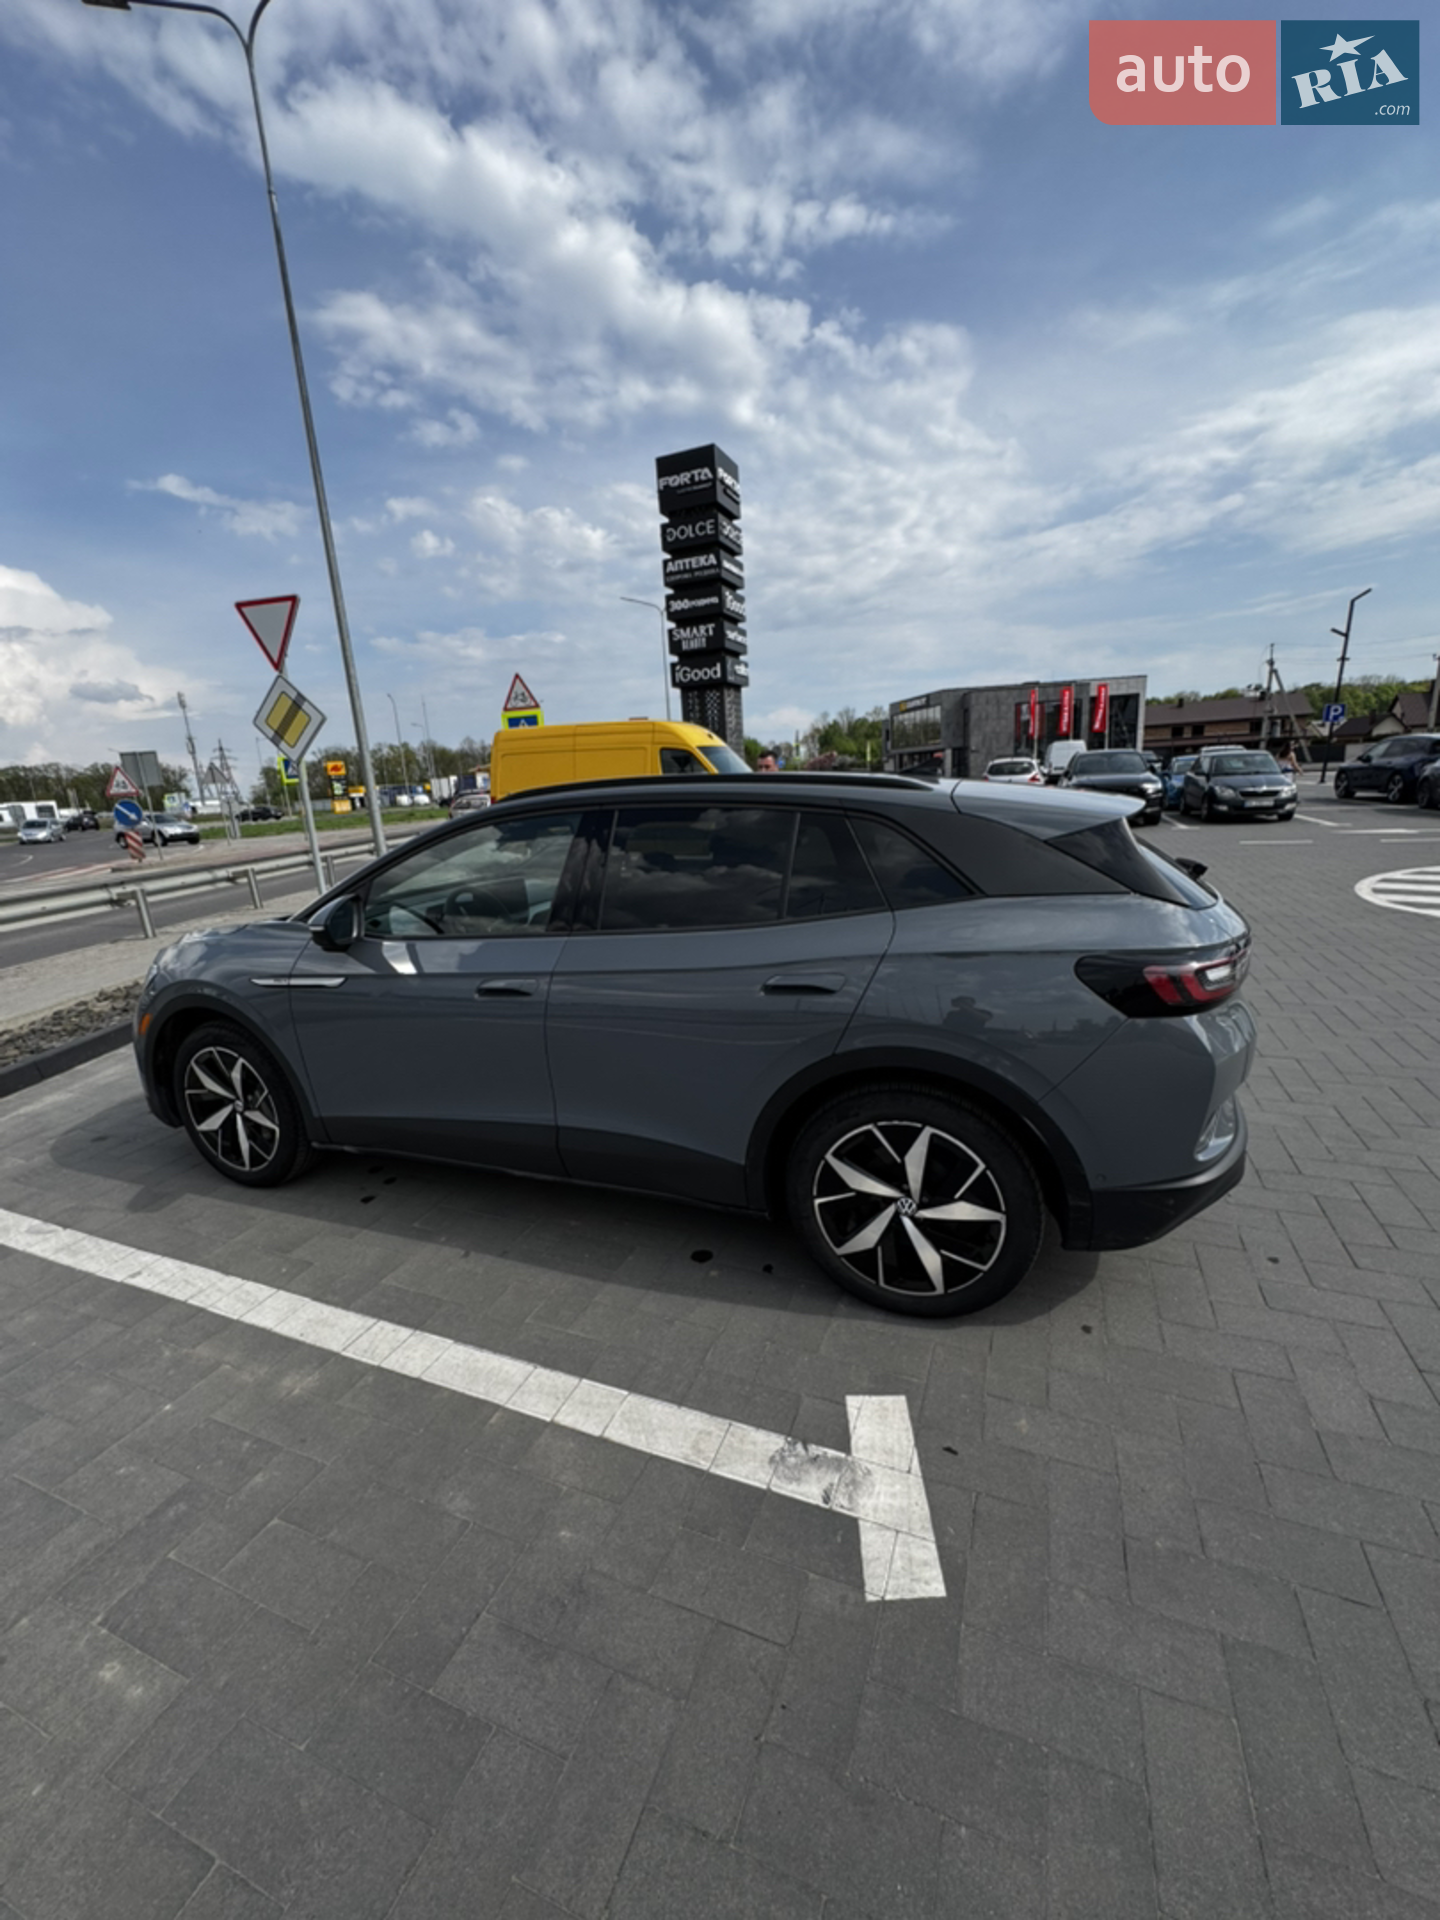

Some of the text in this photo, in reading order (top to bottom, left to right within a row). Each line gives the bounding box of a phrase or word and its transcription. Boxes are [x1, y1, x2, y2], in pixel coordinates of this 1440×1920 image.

[658, 467, 713, 491] FORTA
[666, 519, 716, 542] DOLCE
[666, 553, 718, 574] АПТЕКА
[671, 623, 716, 642] SMART
[675, 662, 721, 684] iGood
[1329, 704, 1343, 721] P
